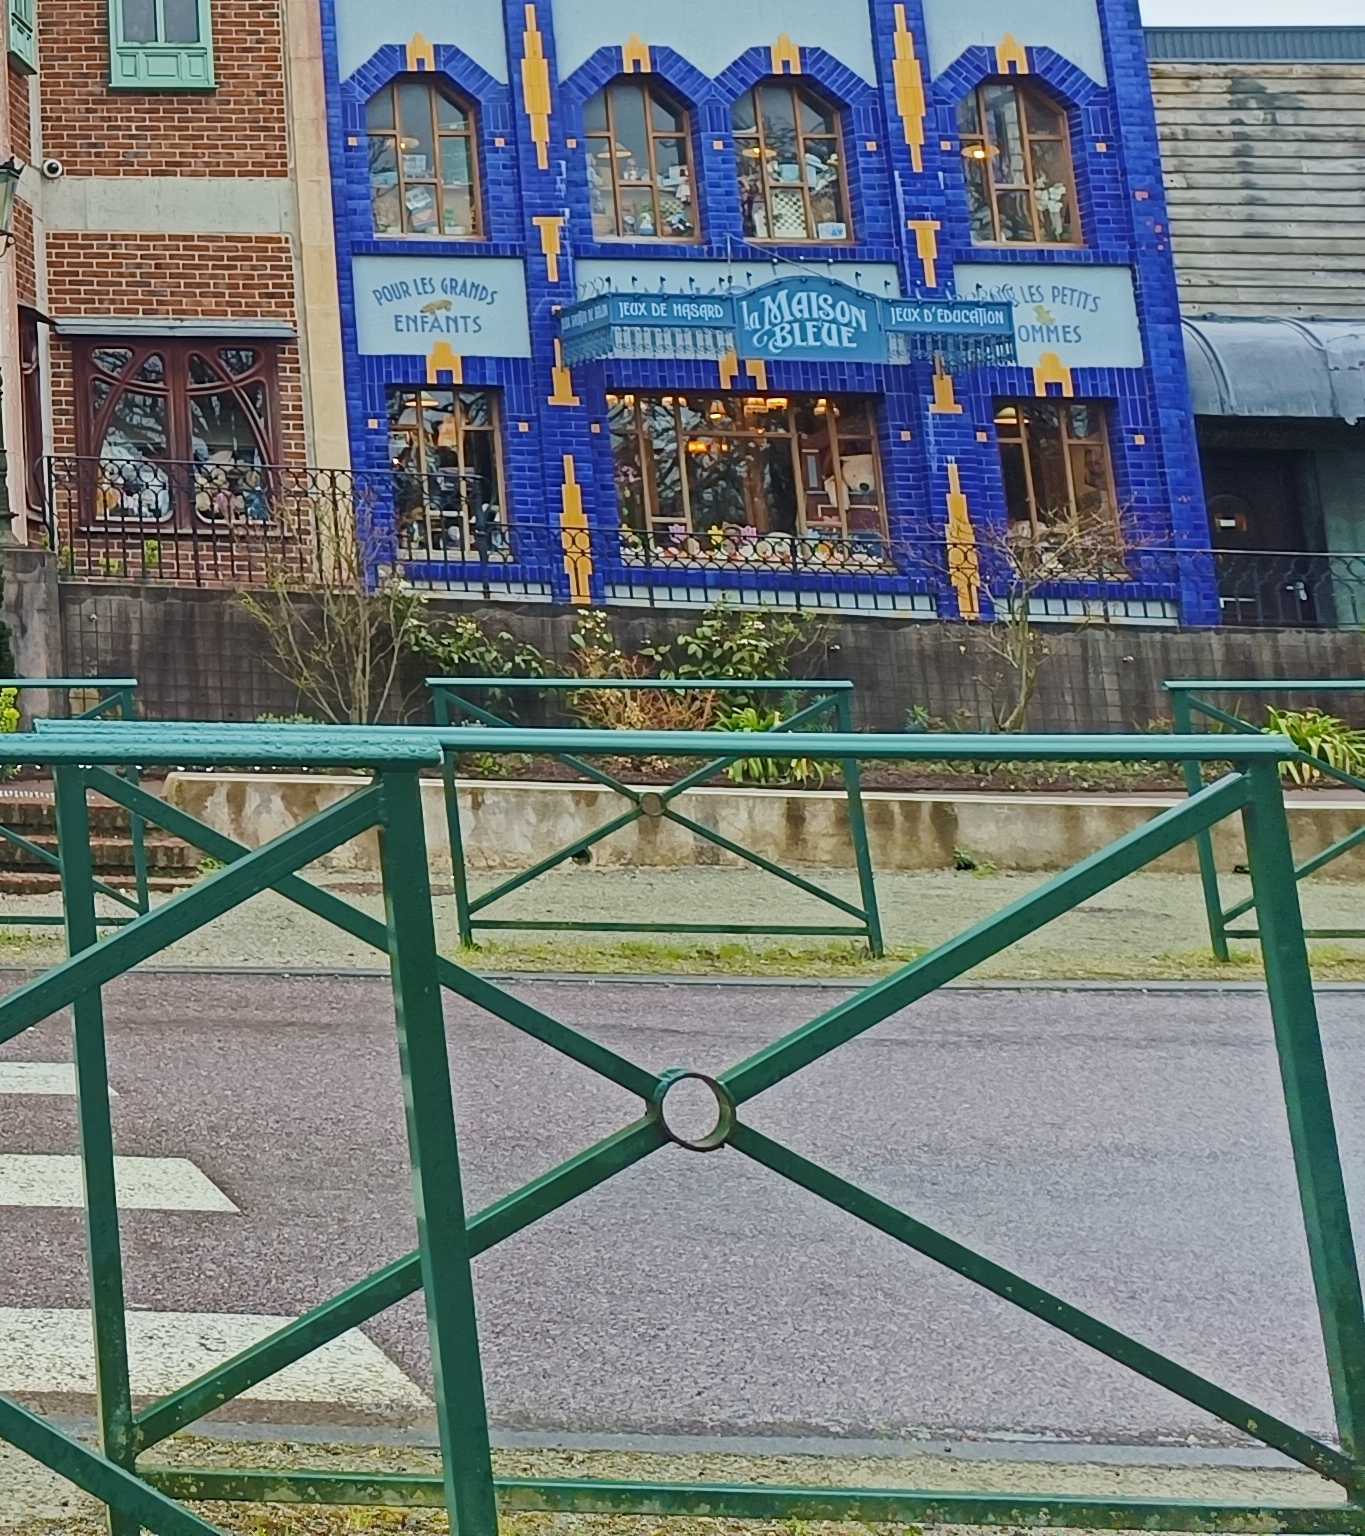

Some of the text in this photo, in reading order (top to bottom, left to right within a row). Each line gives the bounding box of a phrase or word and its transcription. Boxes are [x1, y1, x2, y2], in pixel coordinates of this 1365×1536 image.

[372, 277, 498, 307] POUR LES GRANDS
[1020, 285, 1044, 304] LES
[1052, 285, 1101, 313] PETITS
[394, 314, 482, 333] ENFANTS
[619, 302, 724, 321] JEUX DE HASARD
[741, 289, 867, 347] la MAISON
[890, 306, 1004, 327] JEUX D'EDUCATION
[768, 321, 857, 354] BLEUE
